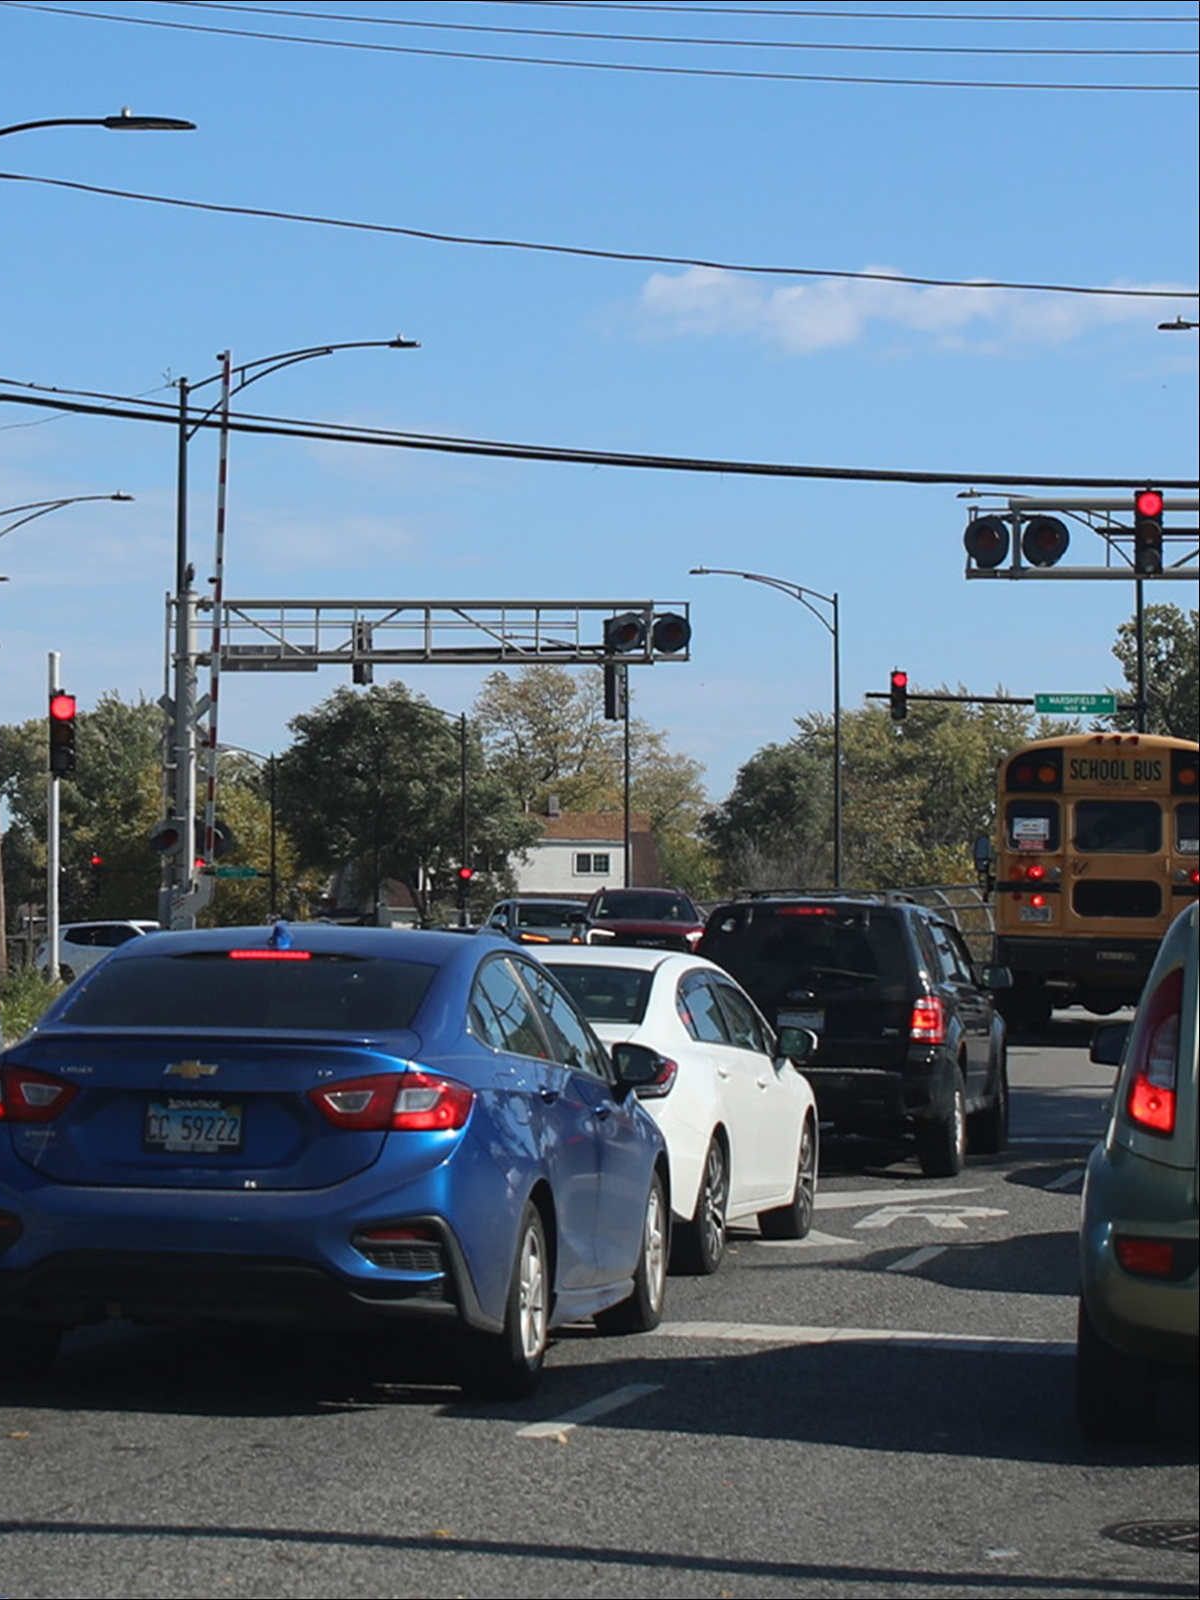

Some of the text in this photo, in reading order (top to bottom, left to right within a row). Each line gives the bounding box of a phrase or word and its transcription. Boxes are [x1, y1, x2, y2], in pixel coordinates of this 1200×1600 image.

[1049, 696, 1097, 705] MARSHFIELD
[1070, 759, 1162, 781] SCHOOL BUS
[147, 1114, 239, 1142] CC 59222
